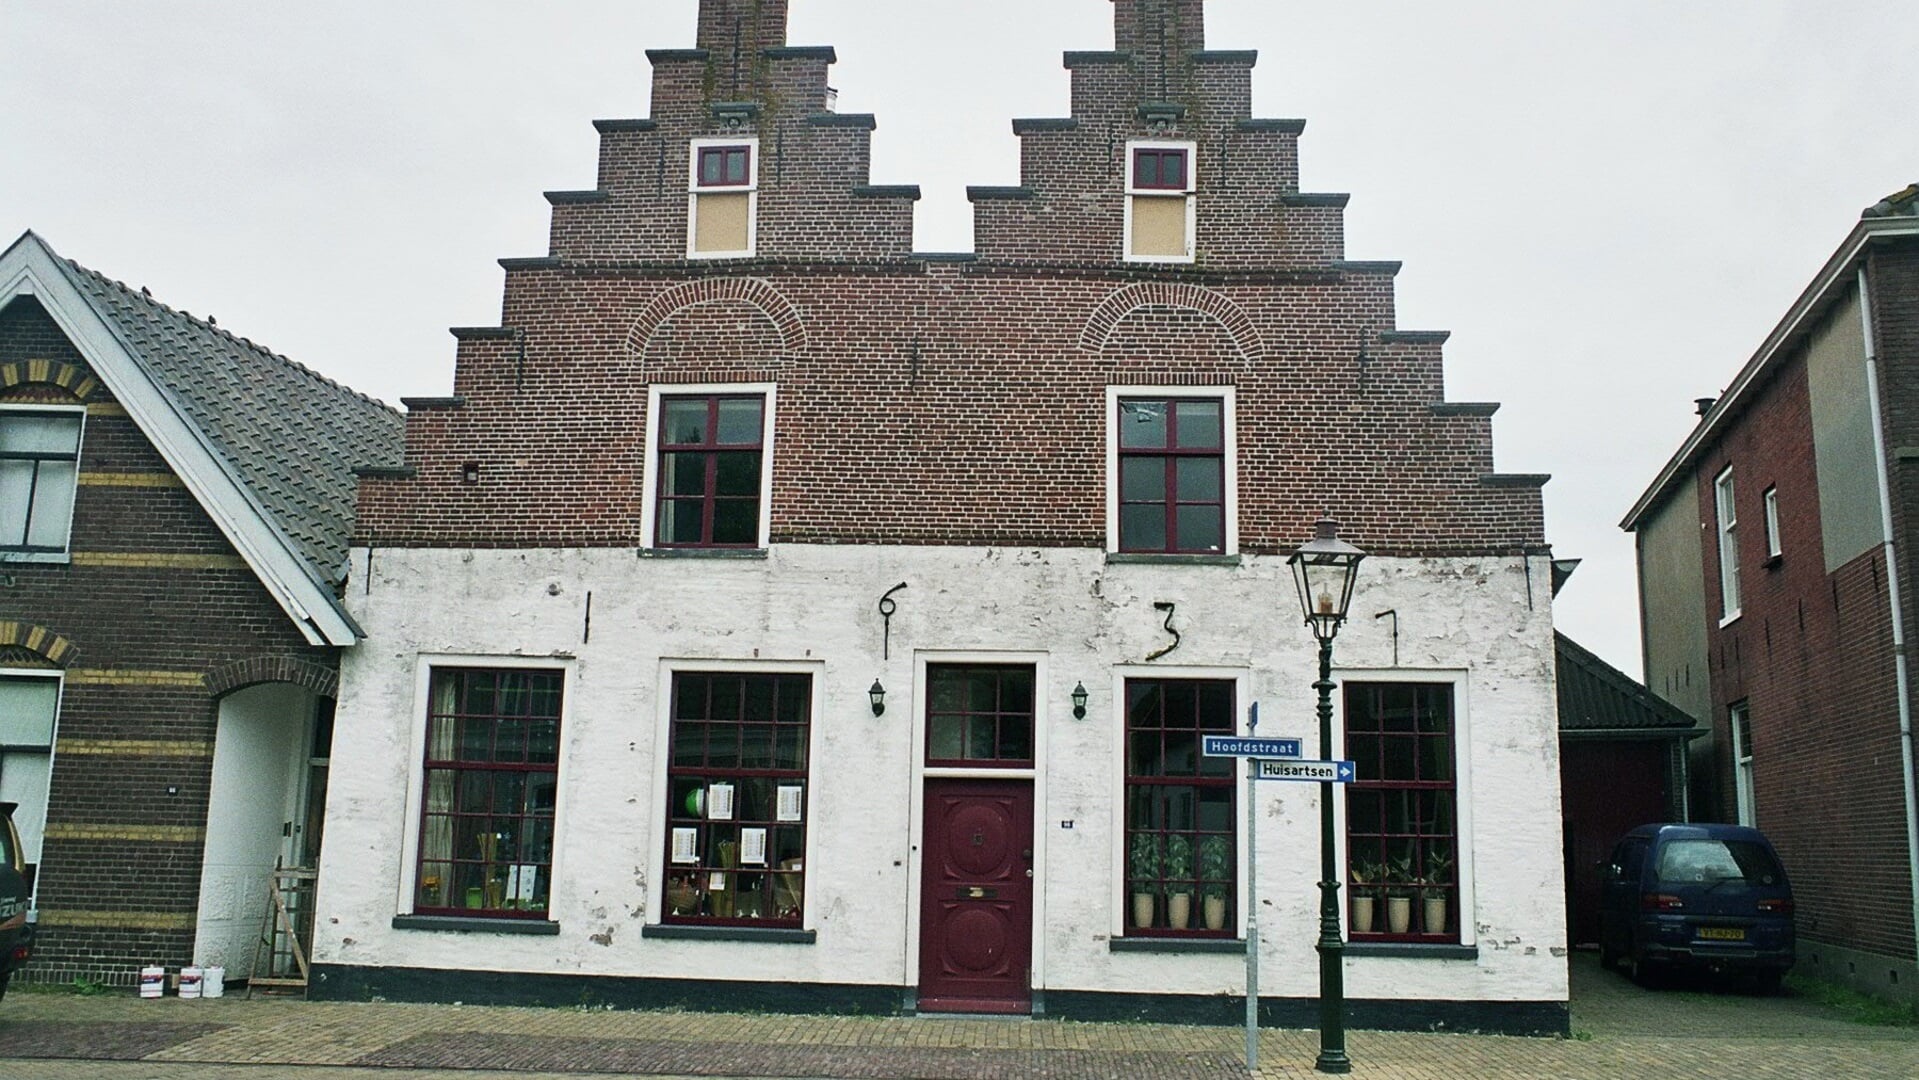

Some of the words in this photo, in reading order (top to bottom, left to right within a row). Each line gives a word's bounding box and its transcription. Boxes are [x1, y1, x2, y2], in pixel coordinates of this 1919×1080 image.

[1145, 602, 1180, 661] 3
[1211, 741, 1293, 753] Hoofdstraat
[1263, 764, 1333, 777] Huisartsen
